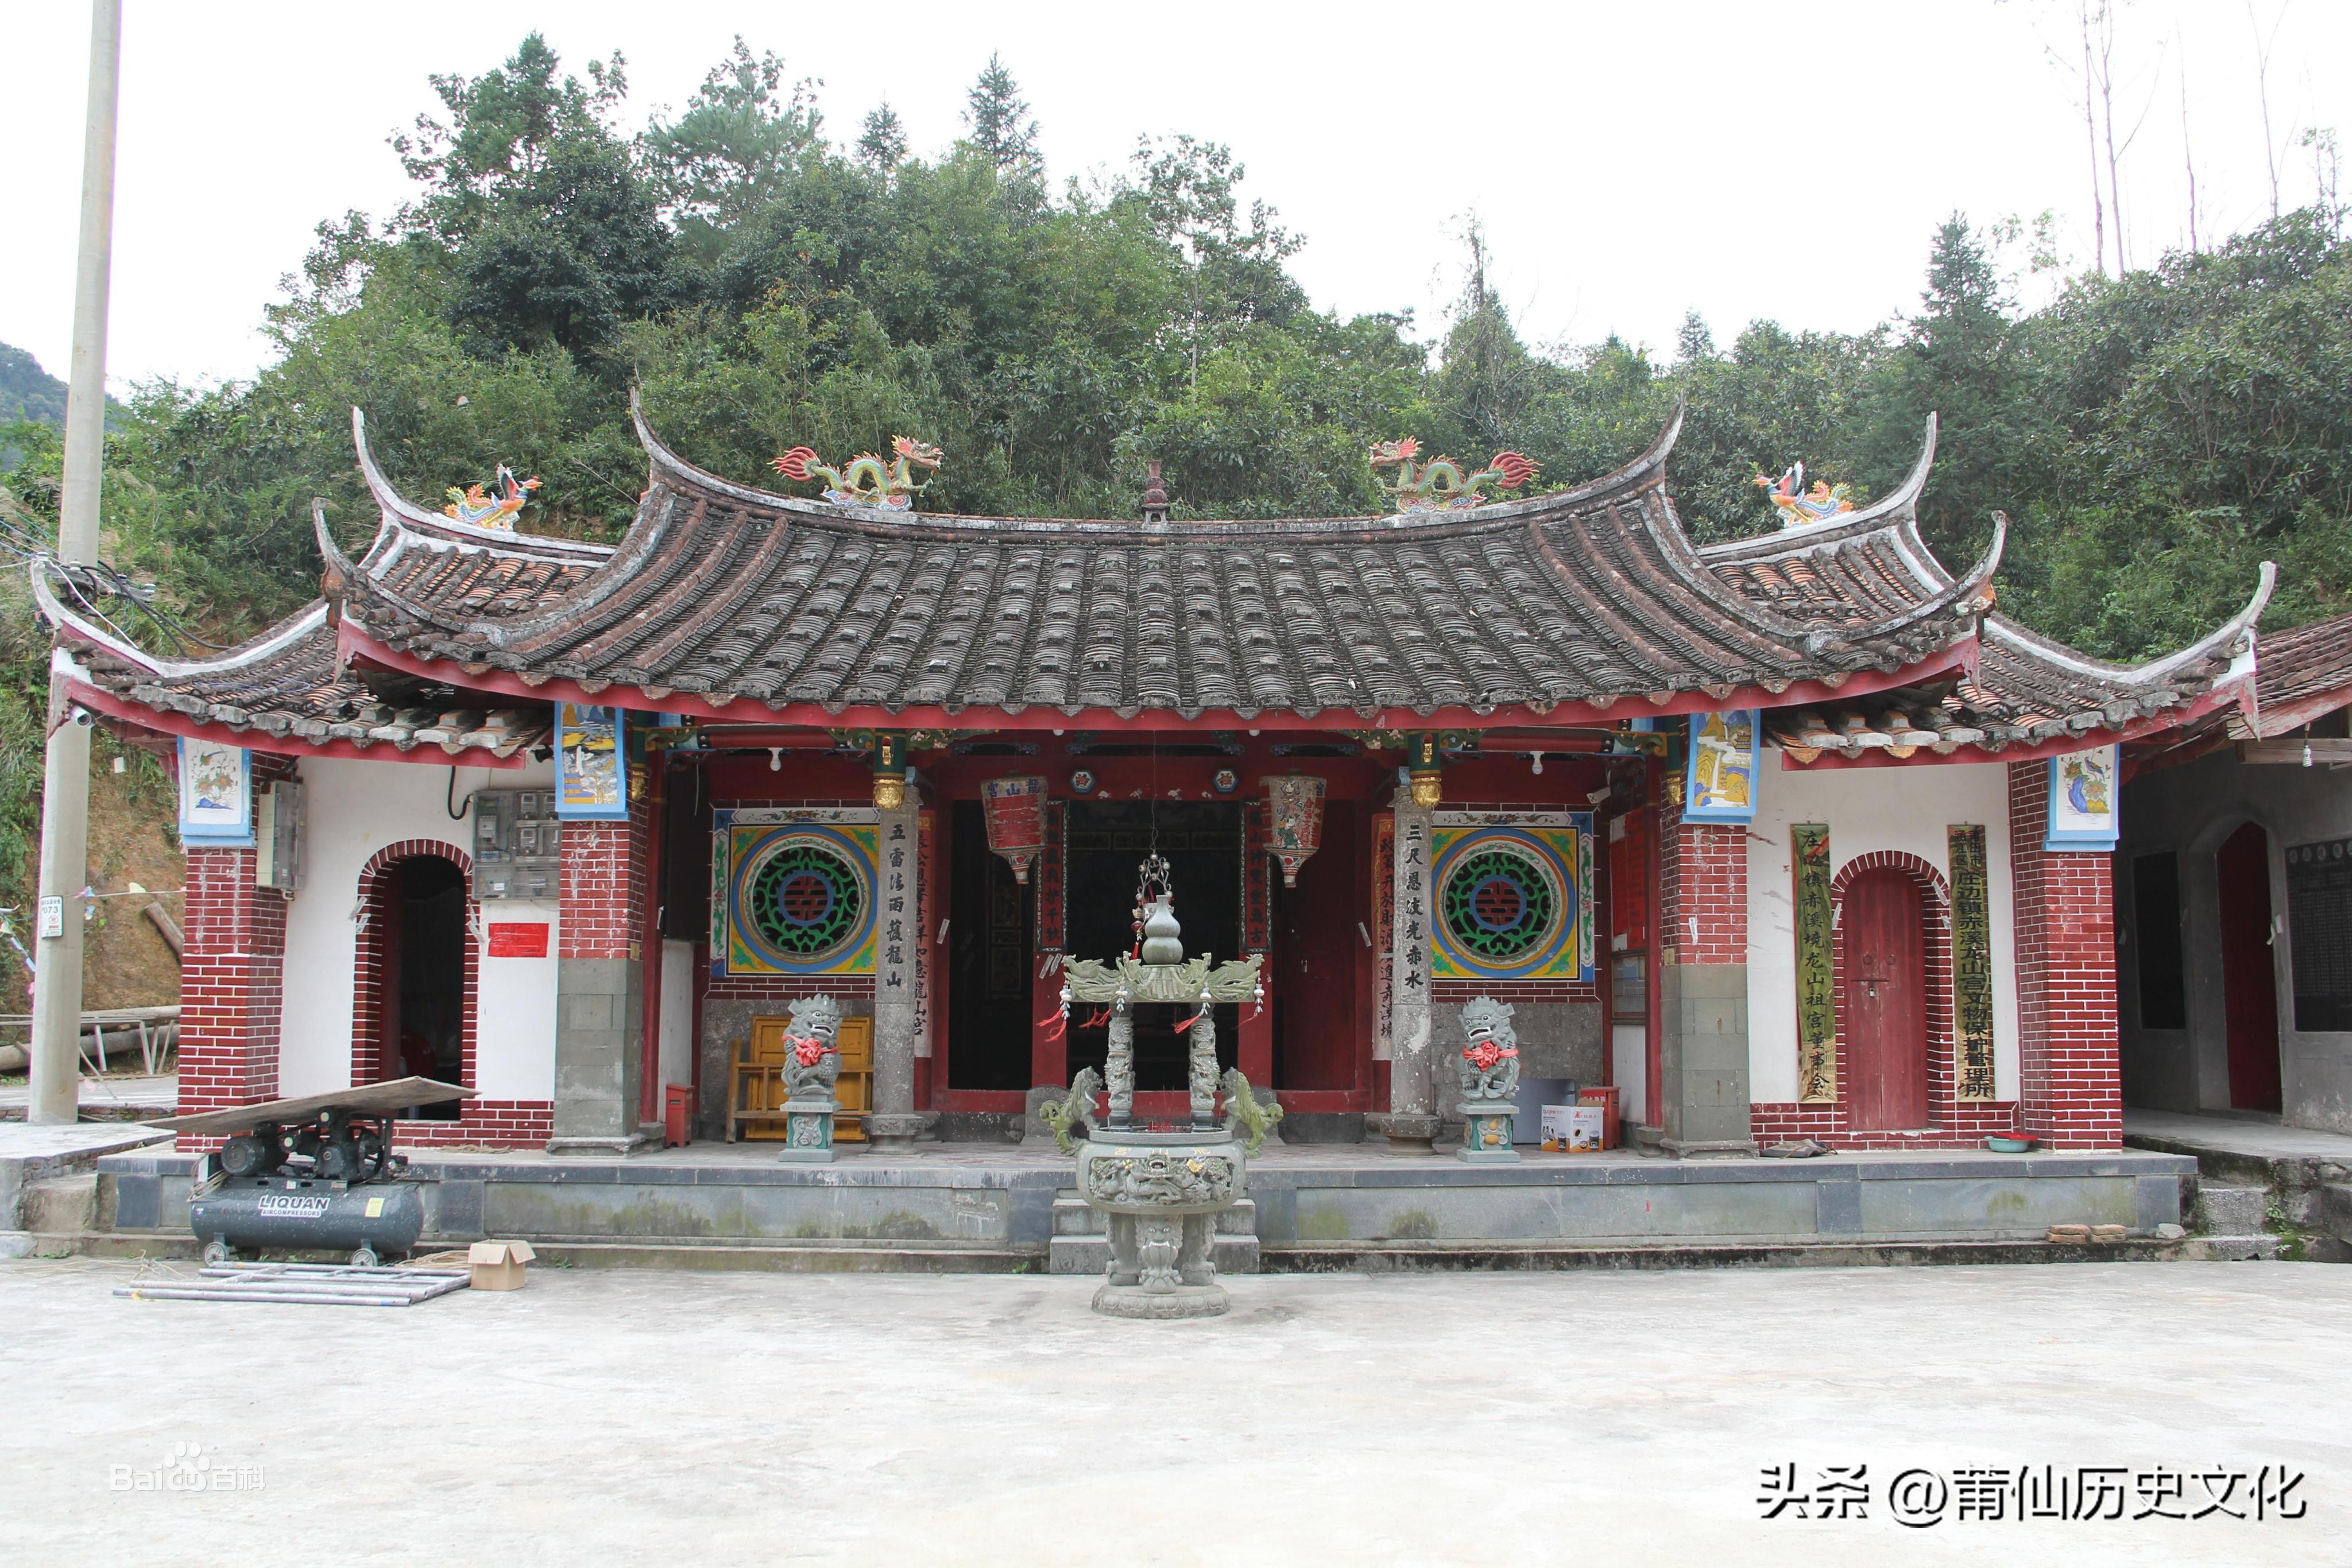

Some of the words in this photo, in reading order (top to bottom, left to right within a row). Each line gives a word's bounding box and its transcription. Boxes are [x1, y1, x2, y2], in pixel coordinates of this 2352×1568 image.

[1405, 824, 1424, 989] 三尺恩波光赤水
[258, 1195, 330, 1211] LIQUAN
